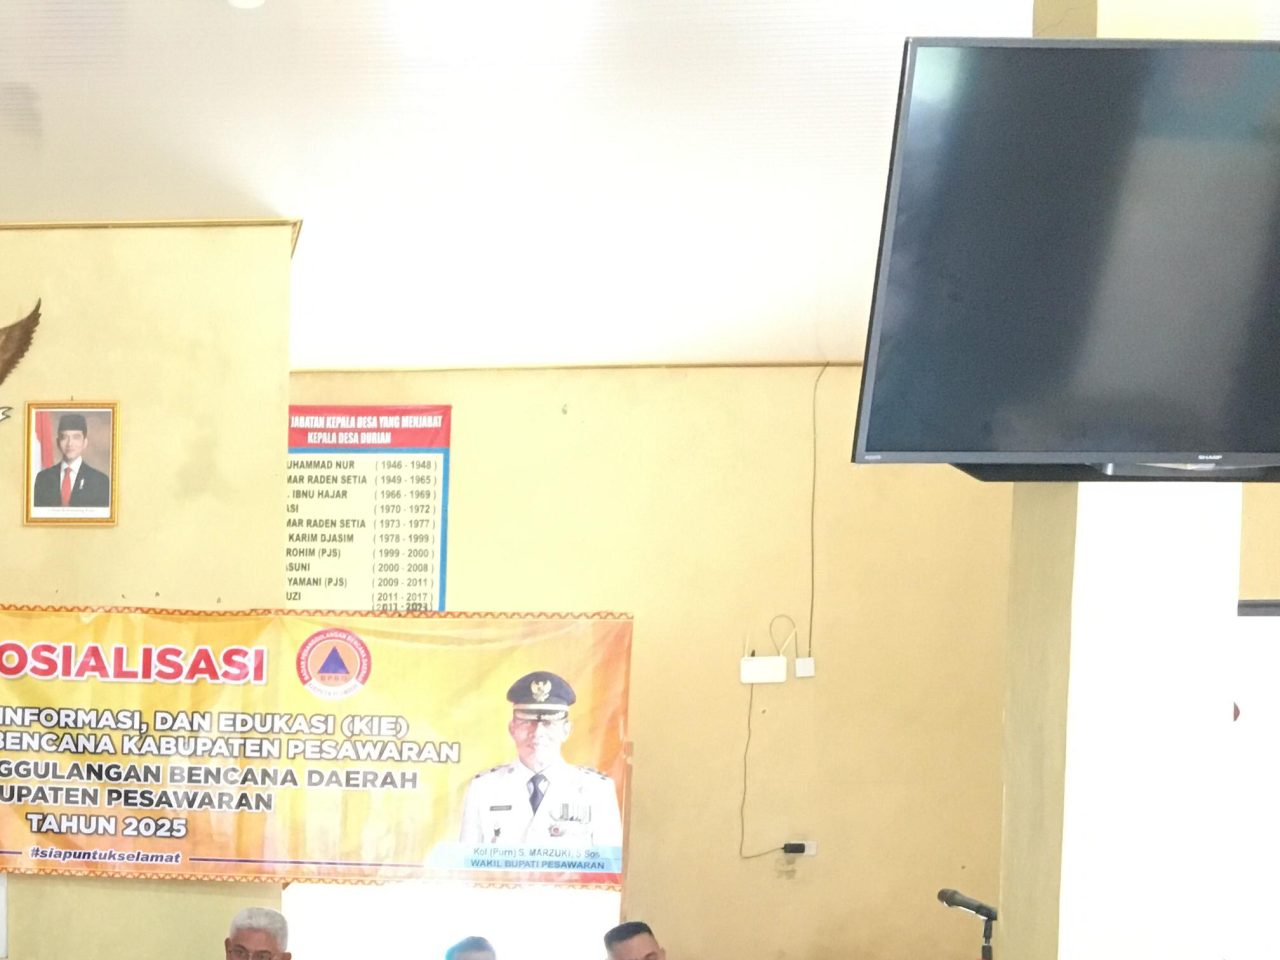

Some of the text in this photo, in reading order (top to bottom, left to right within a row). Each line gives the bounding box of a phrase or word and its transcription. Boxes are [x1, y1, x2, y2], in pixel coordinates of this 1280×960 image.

[326, 415, 356, 428] KEPALA
[357, 415, 377, 428] DESA
[307, 431, 337, 444] KEPALA
[338, 431, 359, 444] DESA
[335, 460, 355, 470] NUR
[307, 475, 338, 484] RADEN
[340, 475, 367, 484] SETIA
[292, 489, 315, 499] IBNU
[317, 489, 348, 499] HAJAR
[306, 518, 337, 528] RADEN
[340, 518, 366, 528] SETIA
[288, 533, 318, 543] KARIM
[320, 533, 354, 543] DJASIM
[318, 548, 341, 559] (PJS)
[286, 562, 311, 572] SUNI
[287, 577, 322, 587] YAMANI
[324, 577, 347, 589] (PJS)
[154, 710, 211, 731] DAN
[218, 711, 336, 735] EDUKASI
[340, 714, 410, 739] (KIE)
[121, 734, 281, 759] KABUPATEN
[287, 738, 461, 763] PESAWARAN
[169, 765, 298, 787] BENCANA
[306, 769, 418, 789] DAERAH
[106, 788, 273, 811] PESAWARAN
[26, 812, 188, 838] TAHUN 2025
[30, 846, 181, 863] #siapuntukselamat
[470, 859, 605, 869] WAKIL BUPATI PESAWARAN
